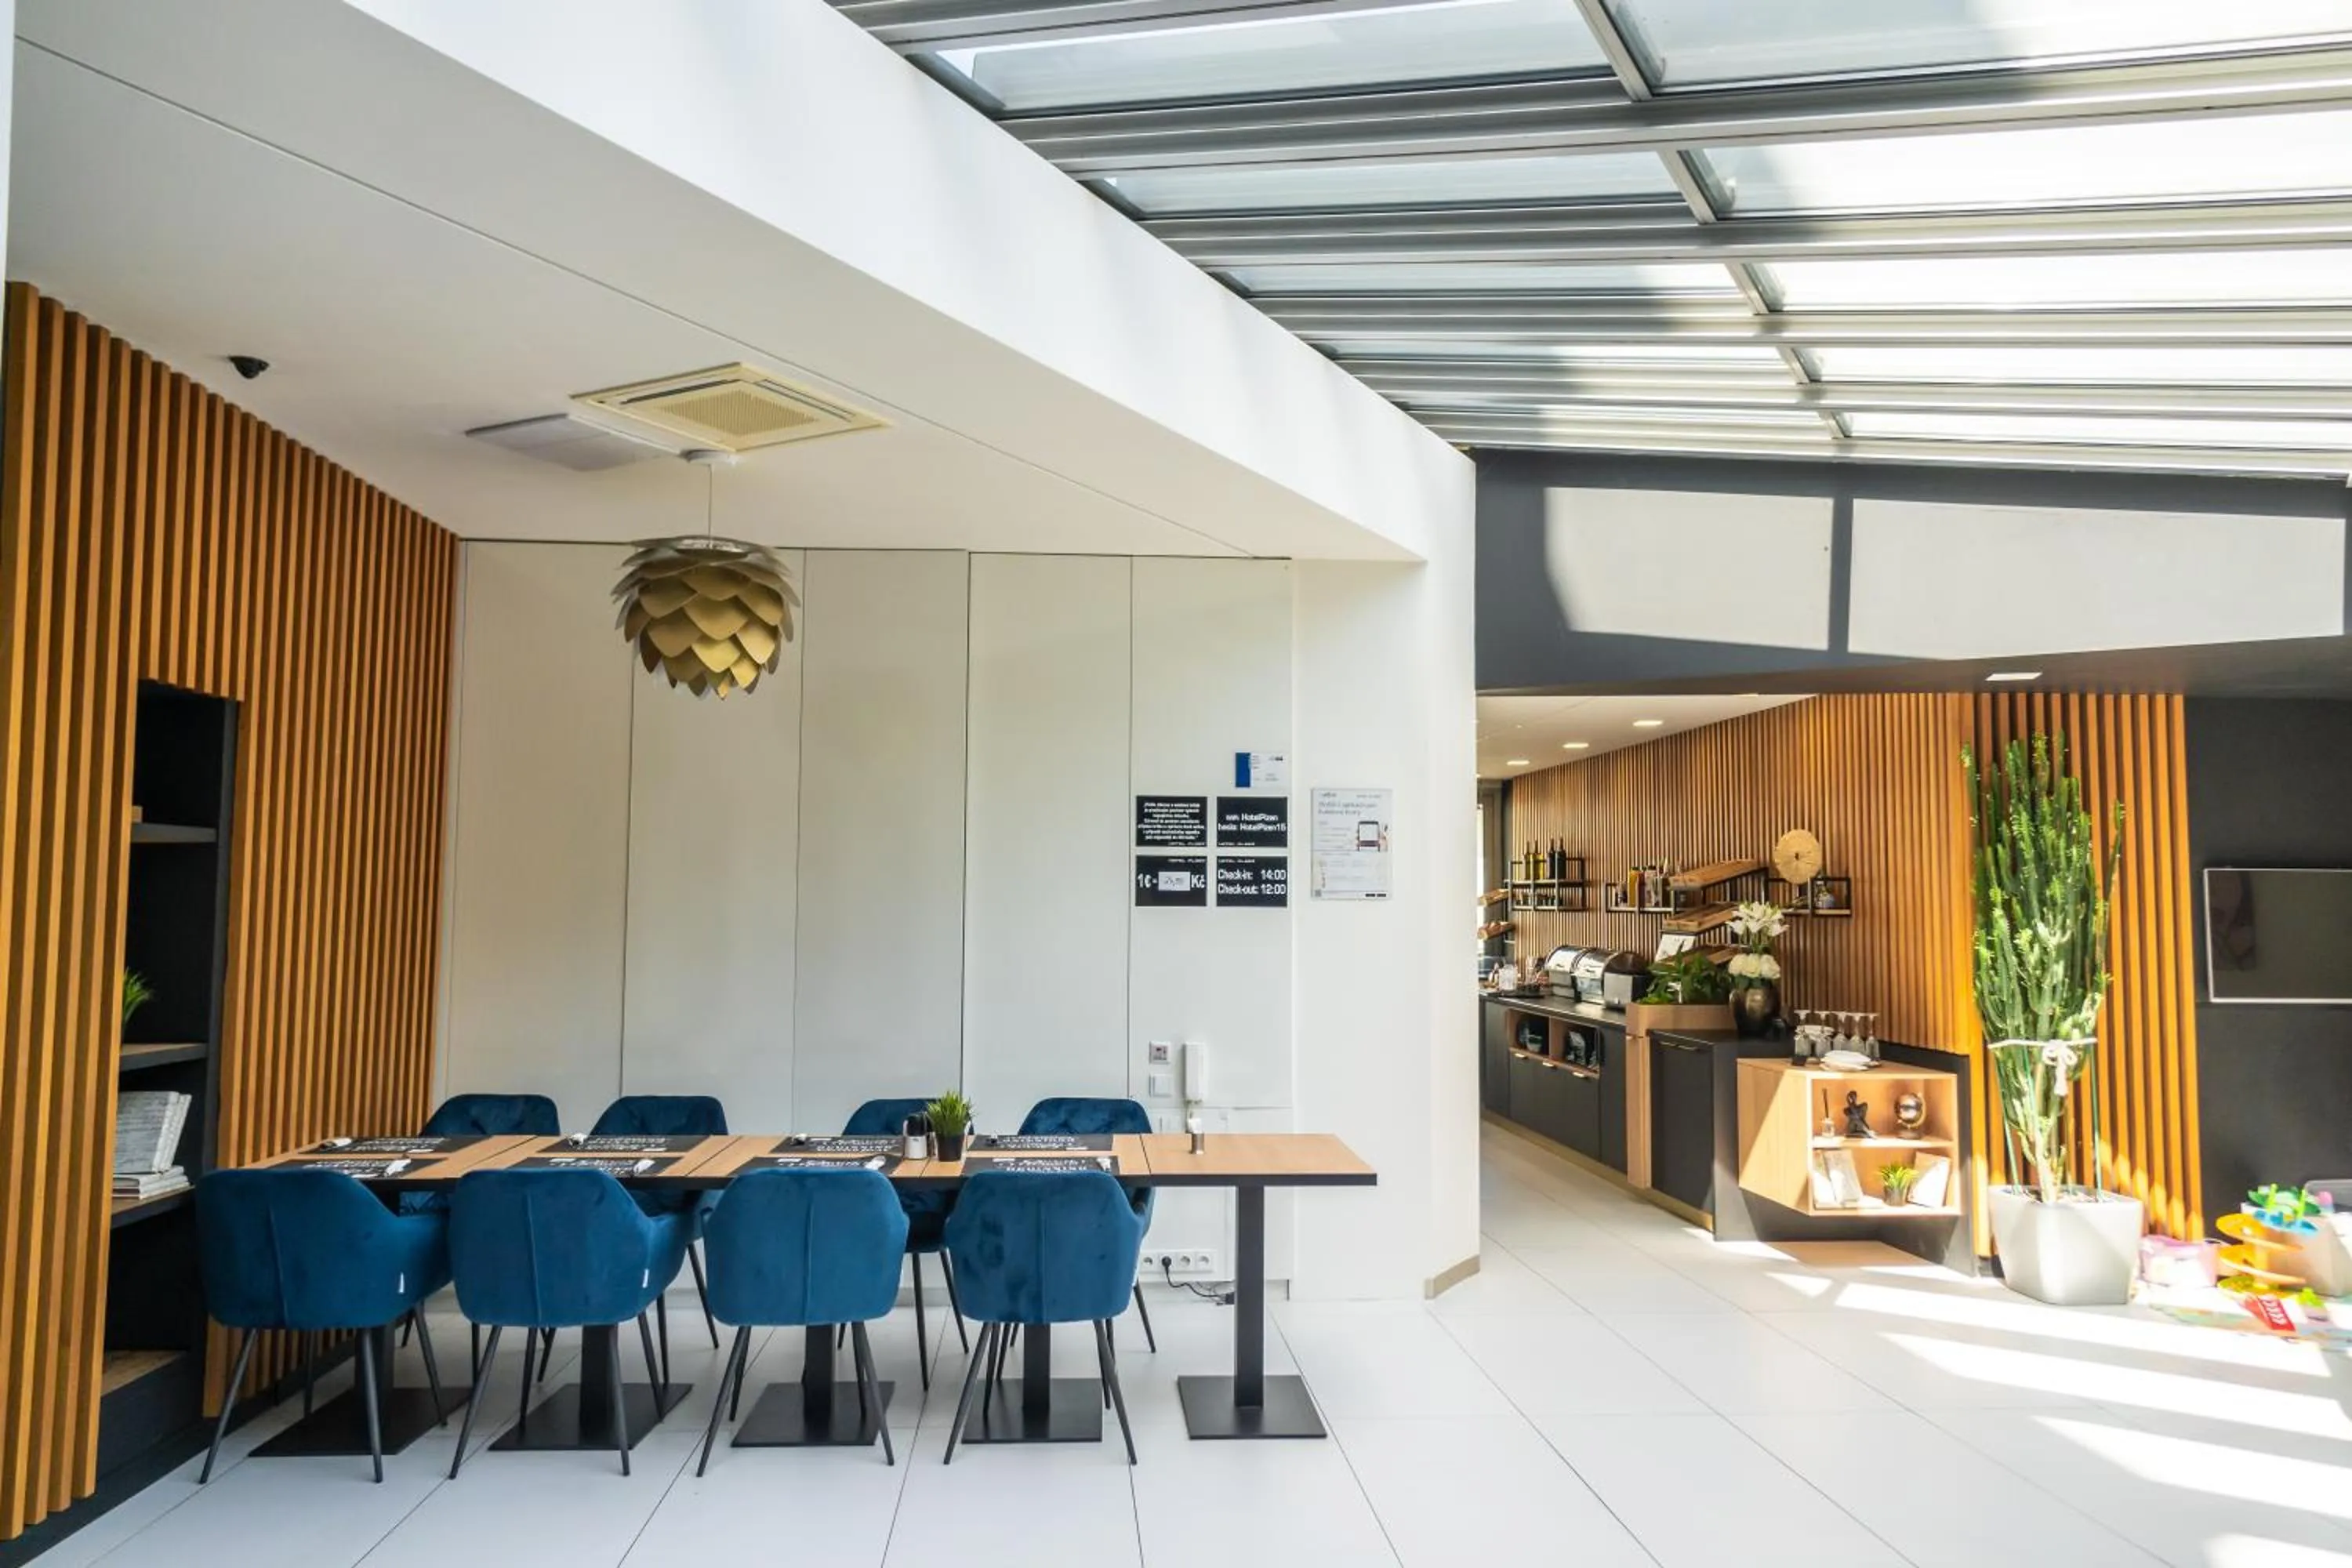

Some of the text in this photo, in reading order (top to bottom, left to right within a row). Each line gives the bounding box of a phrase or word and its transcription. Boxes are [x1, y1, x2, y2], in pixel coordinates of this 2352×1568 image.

[1218, 869, 1287, 880] Check-in: 14:00
[1191, 874, 1205, 888] Kč
[1218, 883, 1287, 895] Check-out: 12:00
